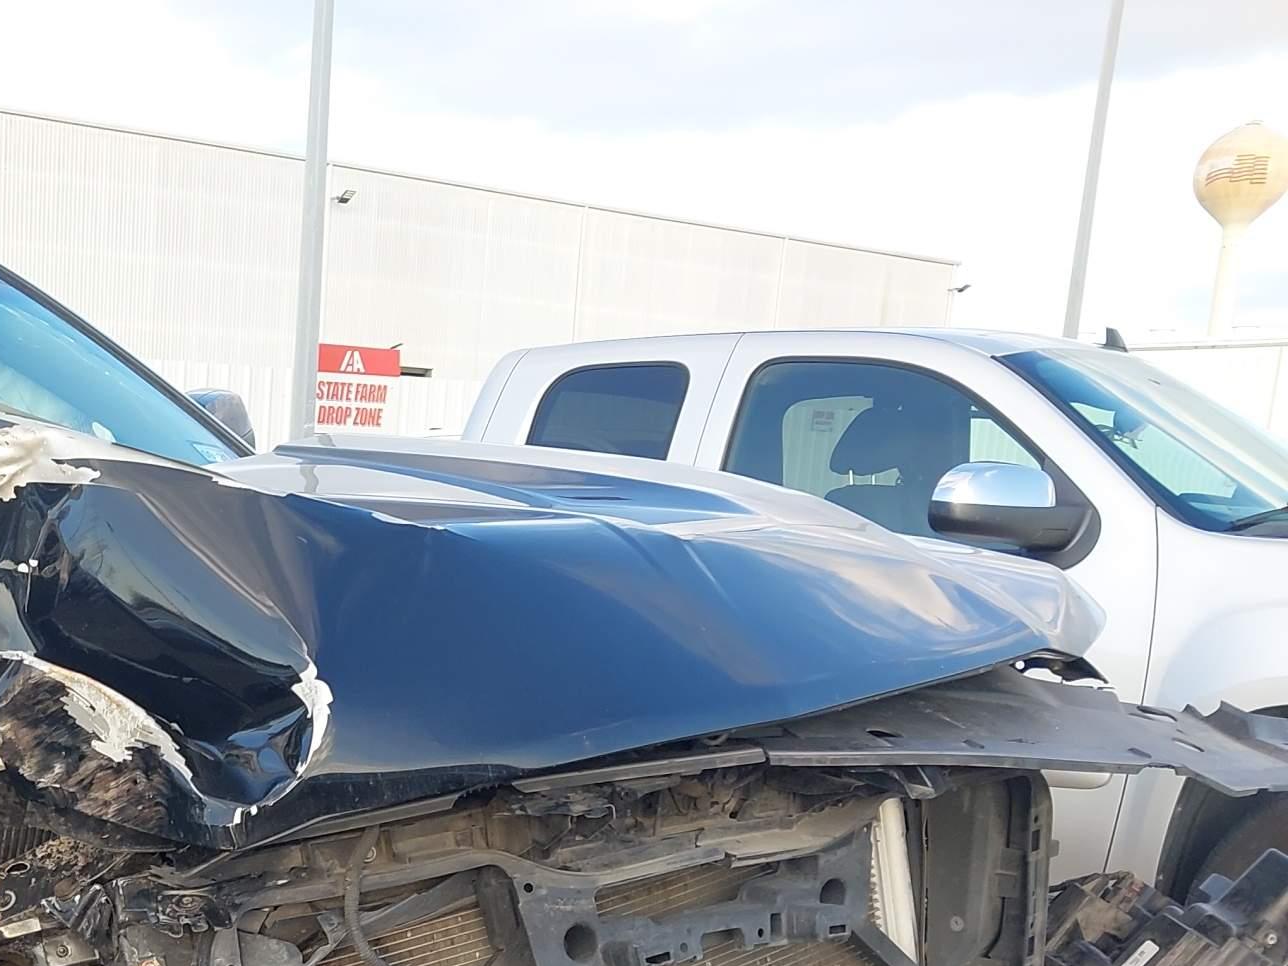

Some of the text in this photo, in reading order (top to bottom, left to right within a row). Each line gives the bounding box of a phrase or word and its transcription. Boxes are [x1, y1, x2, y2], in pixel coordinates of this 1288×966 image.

[316, 380, 388, 403] STATE FARM
[317, 405, 383, 427] DROP ZONE
